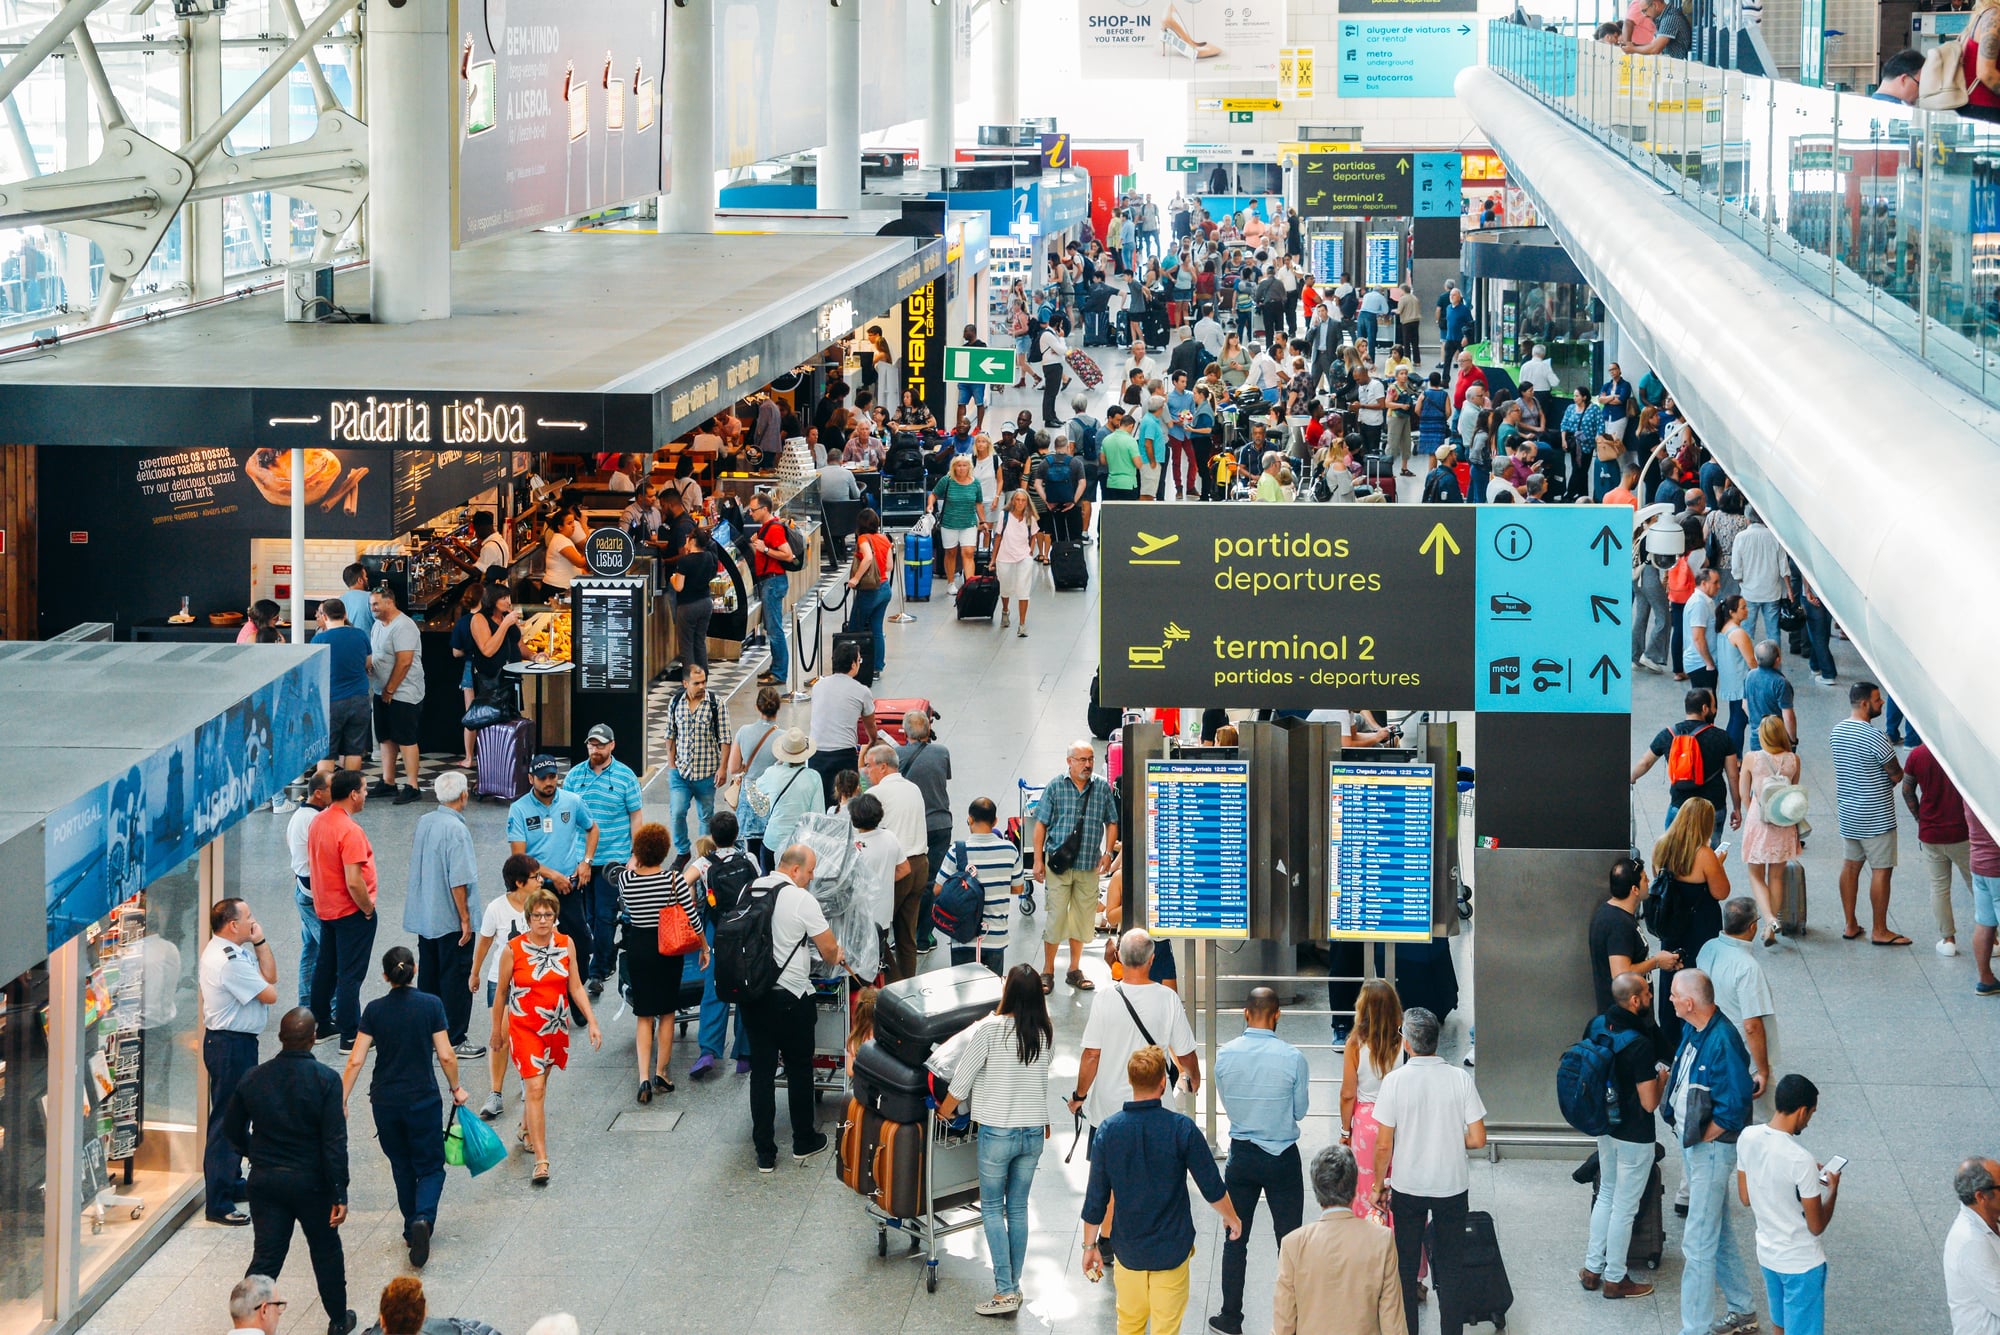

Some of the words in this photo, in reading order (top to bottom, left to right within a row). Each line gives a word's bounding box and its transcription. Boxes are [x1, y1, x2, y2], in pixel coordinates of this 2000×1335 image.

[1088, 16, 1151, 27] SHOP-IN
[1366, 26, 1400, 35] aluguer
[506, 25, 560, 56] BEM-VINDO
[506, 92, 514, 121] A
[1333, 162, 1376, 172] partidas
[1333, 172, 1385, 182] departures
[1333, 193, 1375, 202] terminal
[1378, 193, 1384, 202] 2
[330, 396, 430, 442] Padaria
[139, 452, 189, 470] Experimente
[190, 452, 200, 462] os
[202, 447, 230, 459] nossos
[136, 466, 176, 481] deliciosos
[207, 460, 216, 471] de
[171, 477, 206, 491] delicious
[596, 537, 623, 550] Padaria
[1214, 532, 1349, 563] partidas
[596, 553, 623, 567] Lisboa
[1214, 566, 1382, 595] departures
[1214, 635, 1348, 660] terminal
[1358, 636, 1375, 660] 2
[1214, 669, 1293, 687] partidas
[1310, 669, 1420, 688] departures
[54, 802, 103, 846] PORTUGAL
